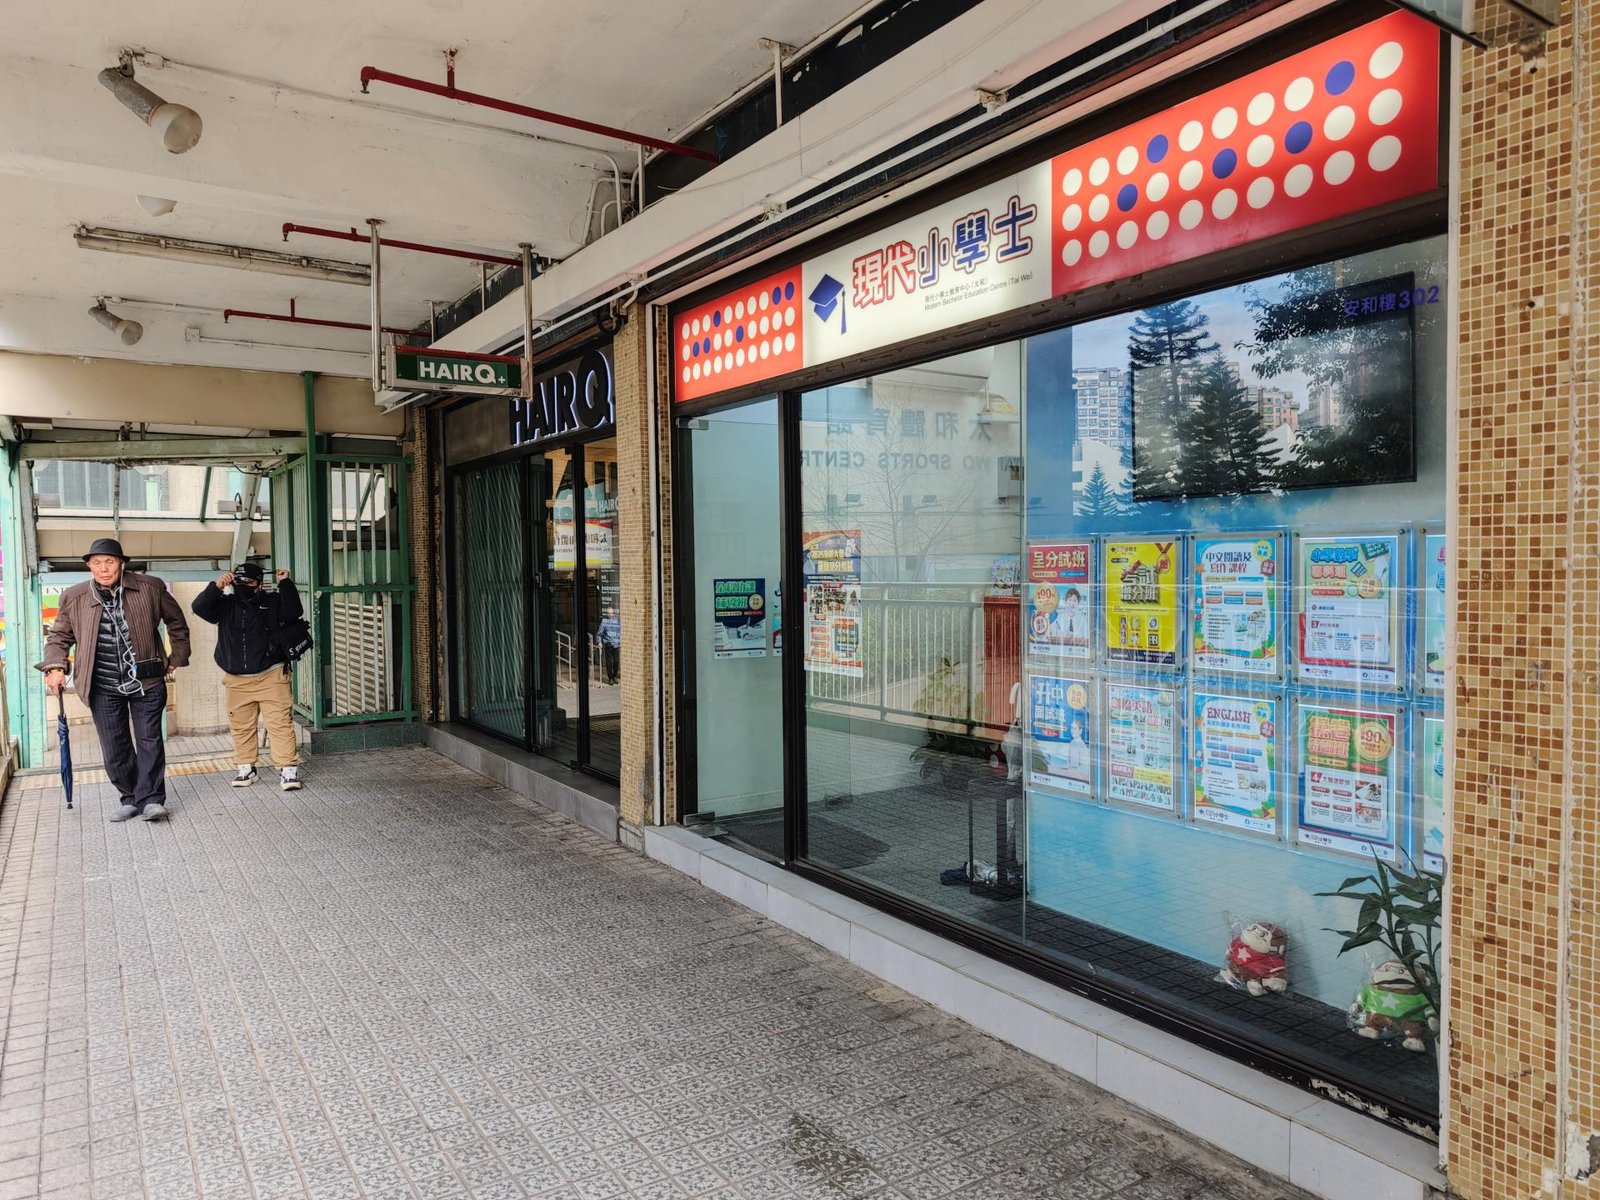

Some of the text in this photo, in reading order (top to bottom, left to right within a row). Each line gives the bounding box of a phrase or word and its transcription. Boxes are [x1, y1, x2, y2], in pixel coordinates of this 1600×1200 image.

[853, 195, 1037, 309] 現代小學士
[924, 301, 945, 311] Modern
[942, 295, 963, 306] Bachelor
[964, 287, 989, 299] Education
[989, 282, 1008, 291] Centre
[1343, 285, 1440, 318] 安和樓302
[1033, 550, 1086, 569] 呈分試班
[1205, 551, 1253, 563] 中文閱讀及
